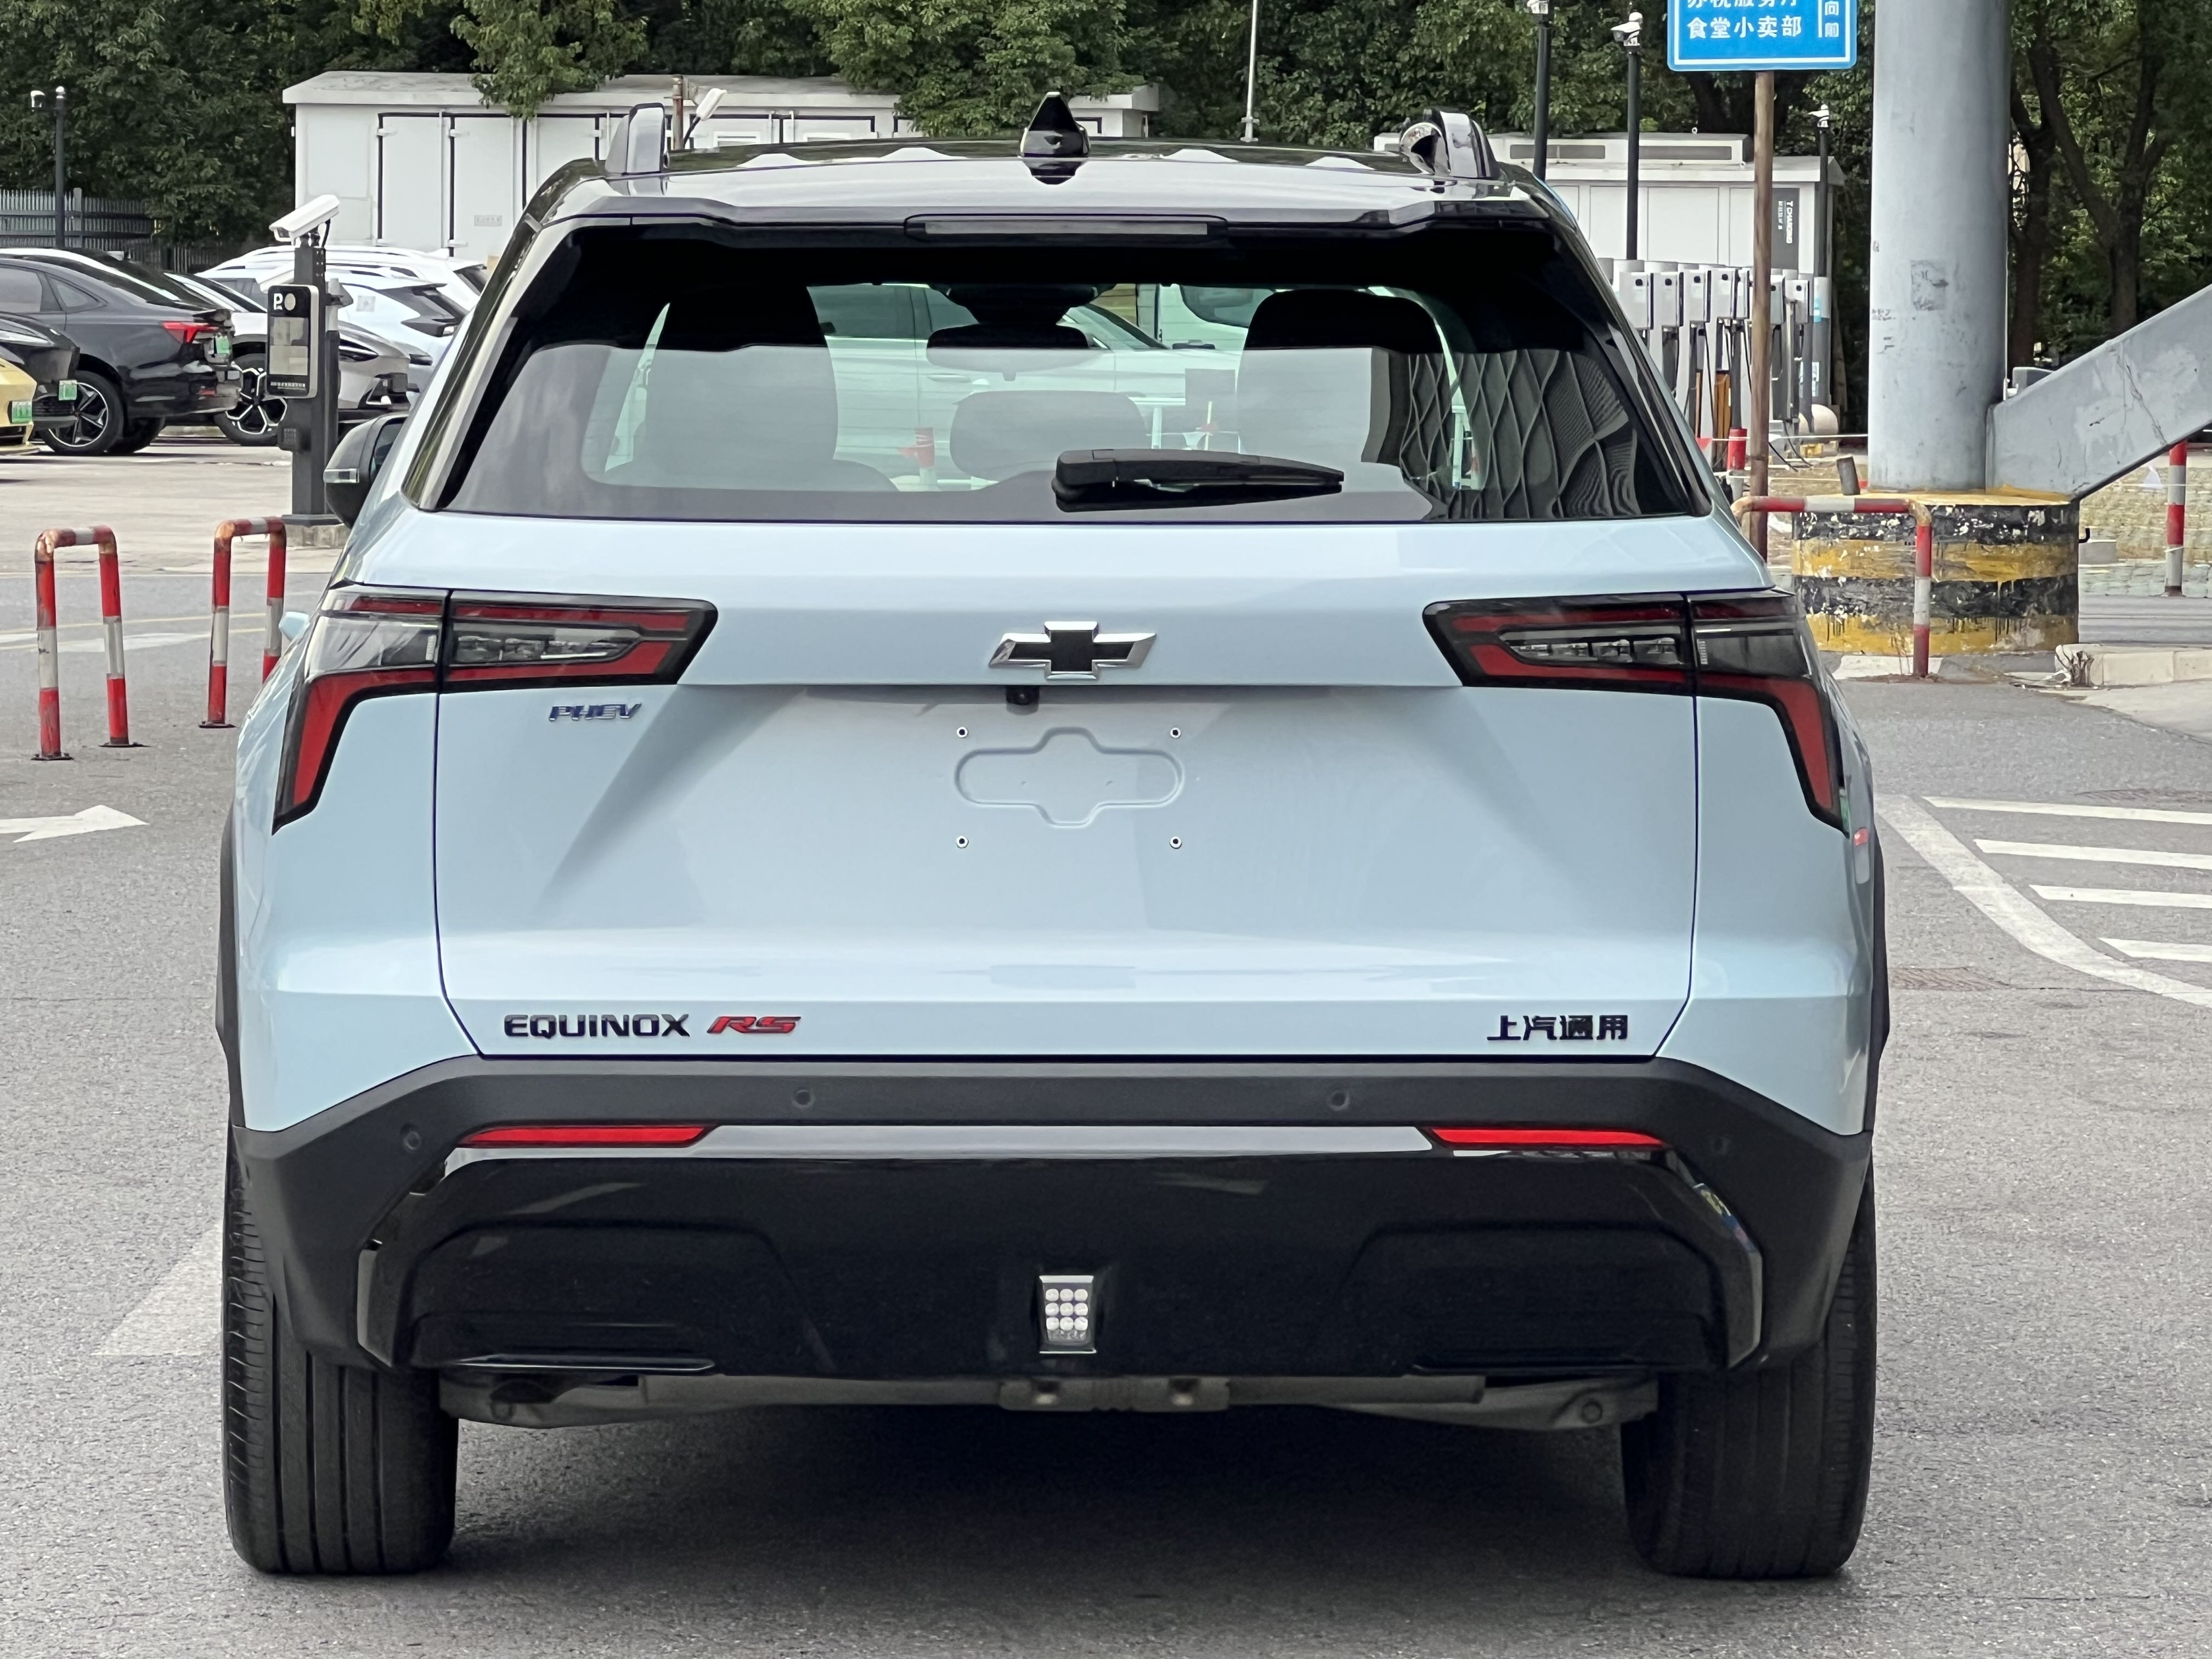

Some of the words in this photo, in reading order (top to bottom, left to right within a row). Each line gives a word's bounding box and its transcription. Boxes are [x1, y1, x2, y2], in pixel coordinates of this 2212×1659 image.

[1687, 15, 1802, 39] 食堂小卖部
[549, 702, 642, 721] PHEV
[504, 1014, 690, 1039] EQUINOX
[707, 1016, 802, 1034] RS
[1487, 1015, 1628, 1040] 上汽通用
